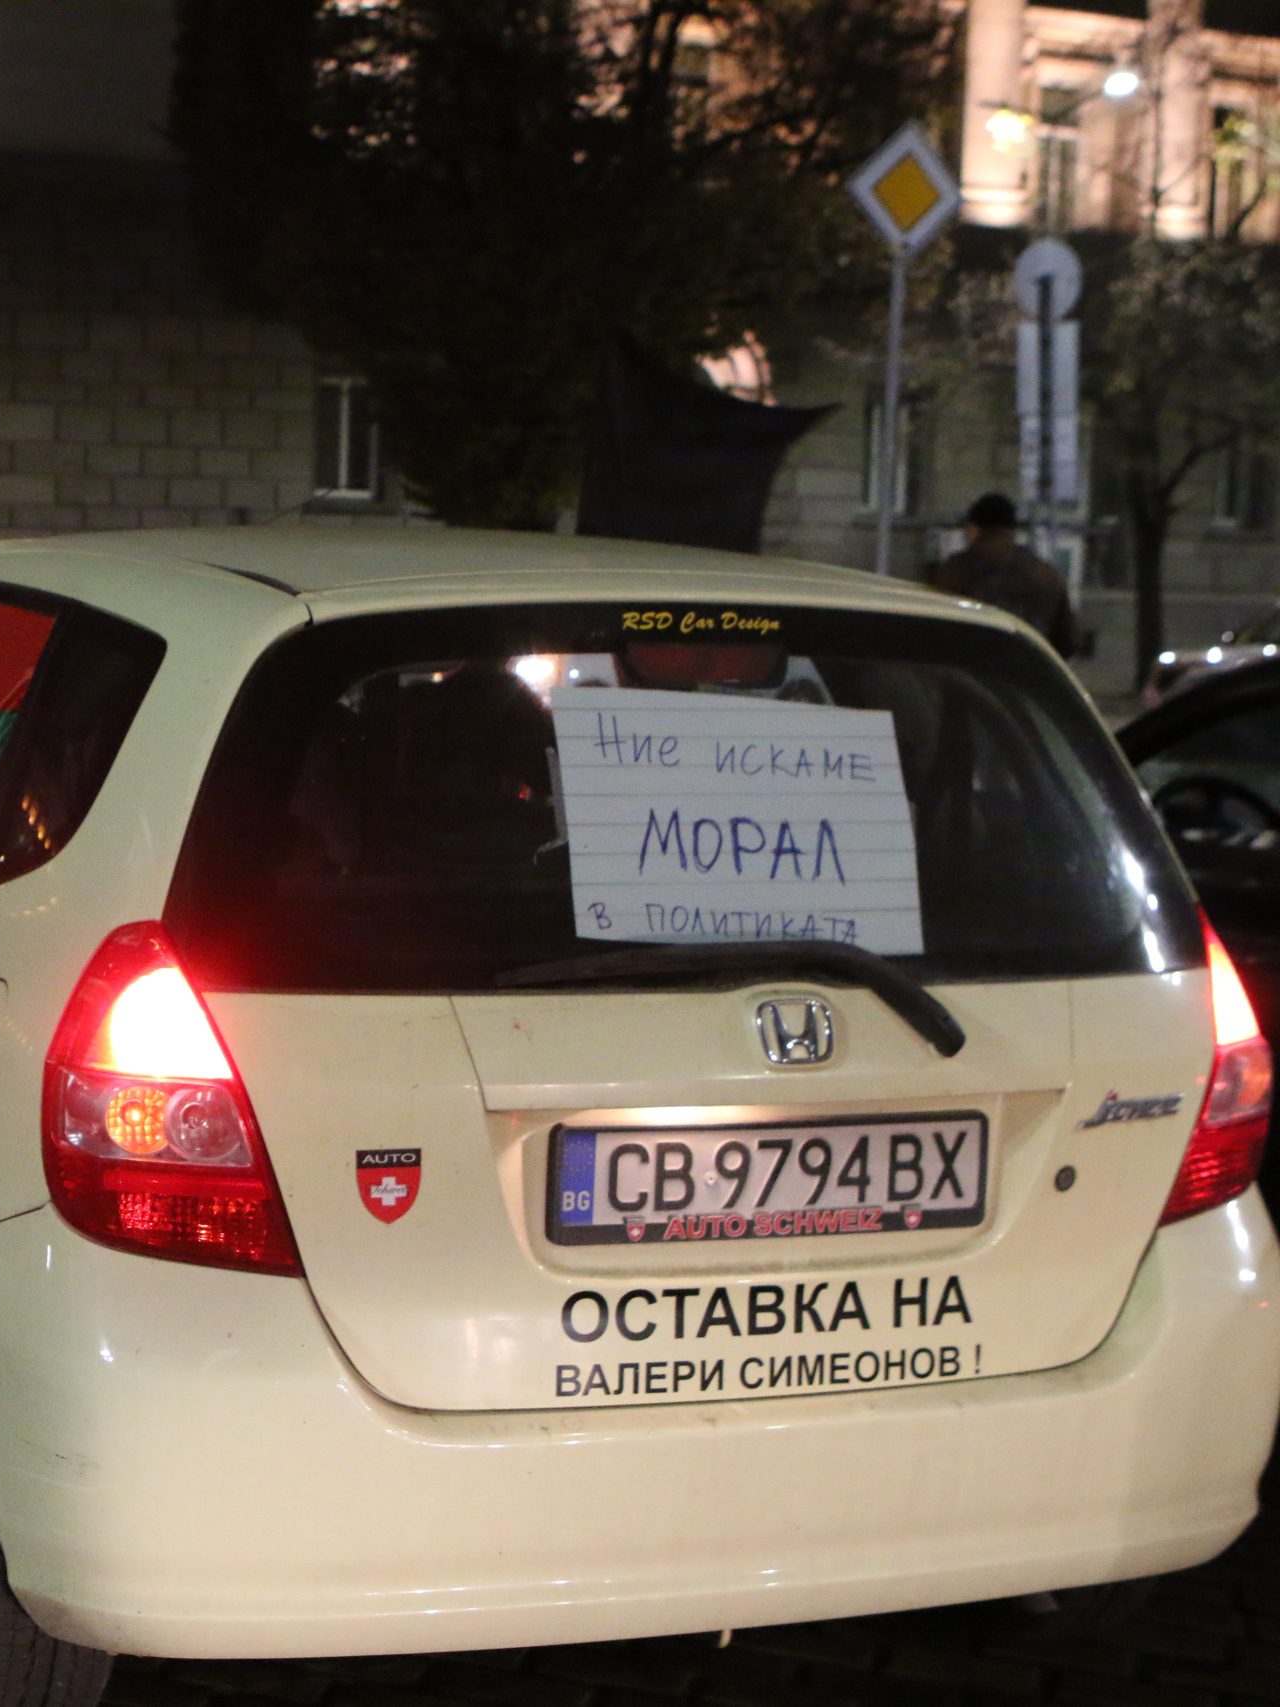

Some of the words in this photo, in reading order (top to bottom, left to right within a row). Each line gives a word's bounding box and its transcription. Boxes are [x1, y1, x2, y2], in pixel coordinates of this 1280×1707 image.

[622, 611, 673, 631] RSD
[679, 610, 715, 634] Car
[720, 611, 781, 635] Design
[594, 712, 681, 768] Ние
[638, 808, 846, 886] МОРАЛ
[645, 903, 858, 945] ПОЛИТИКАТА
[362, 1153, 416, 1164] AUTO
[608, 1143, 695, 1212] CB
[715, 1135, 870, 1209] 9794
[888, 1131, 968, 1203] BX
[562, 1190, 590, 1213] BG
[663, 1213, 748, 1241] AUTO
[754, 1207, 884, 1238] SCHWEIZ
[561, 1280, 871, 1343] ОСТАВКА
[893, 1275, 972, 1329] НА
[556, 1358, 724, 1397] ВАЛЕРИ
